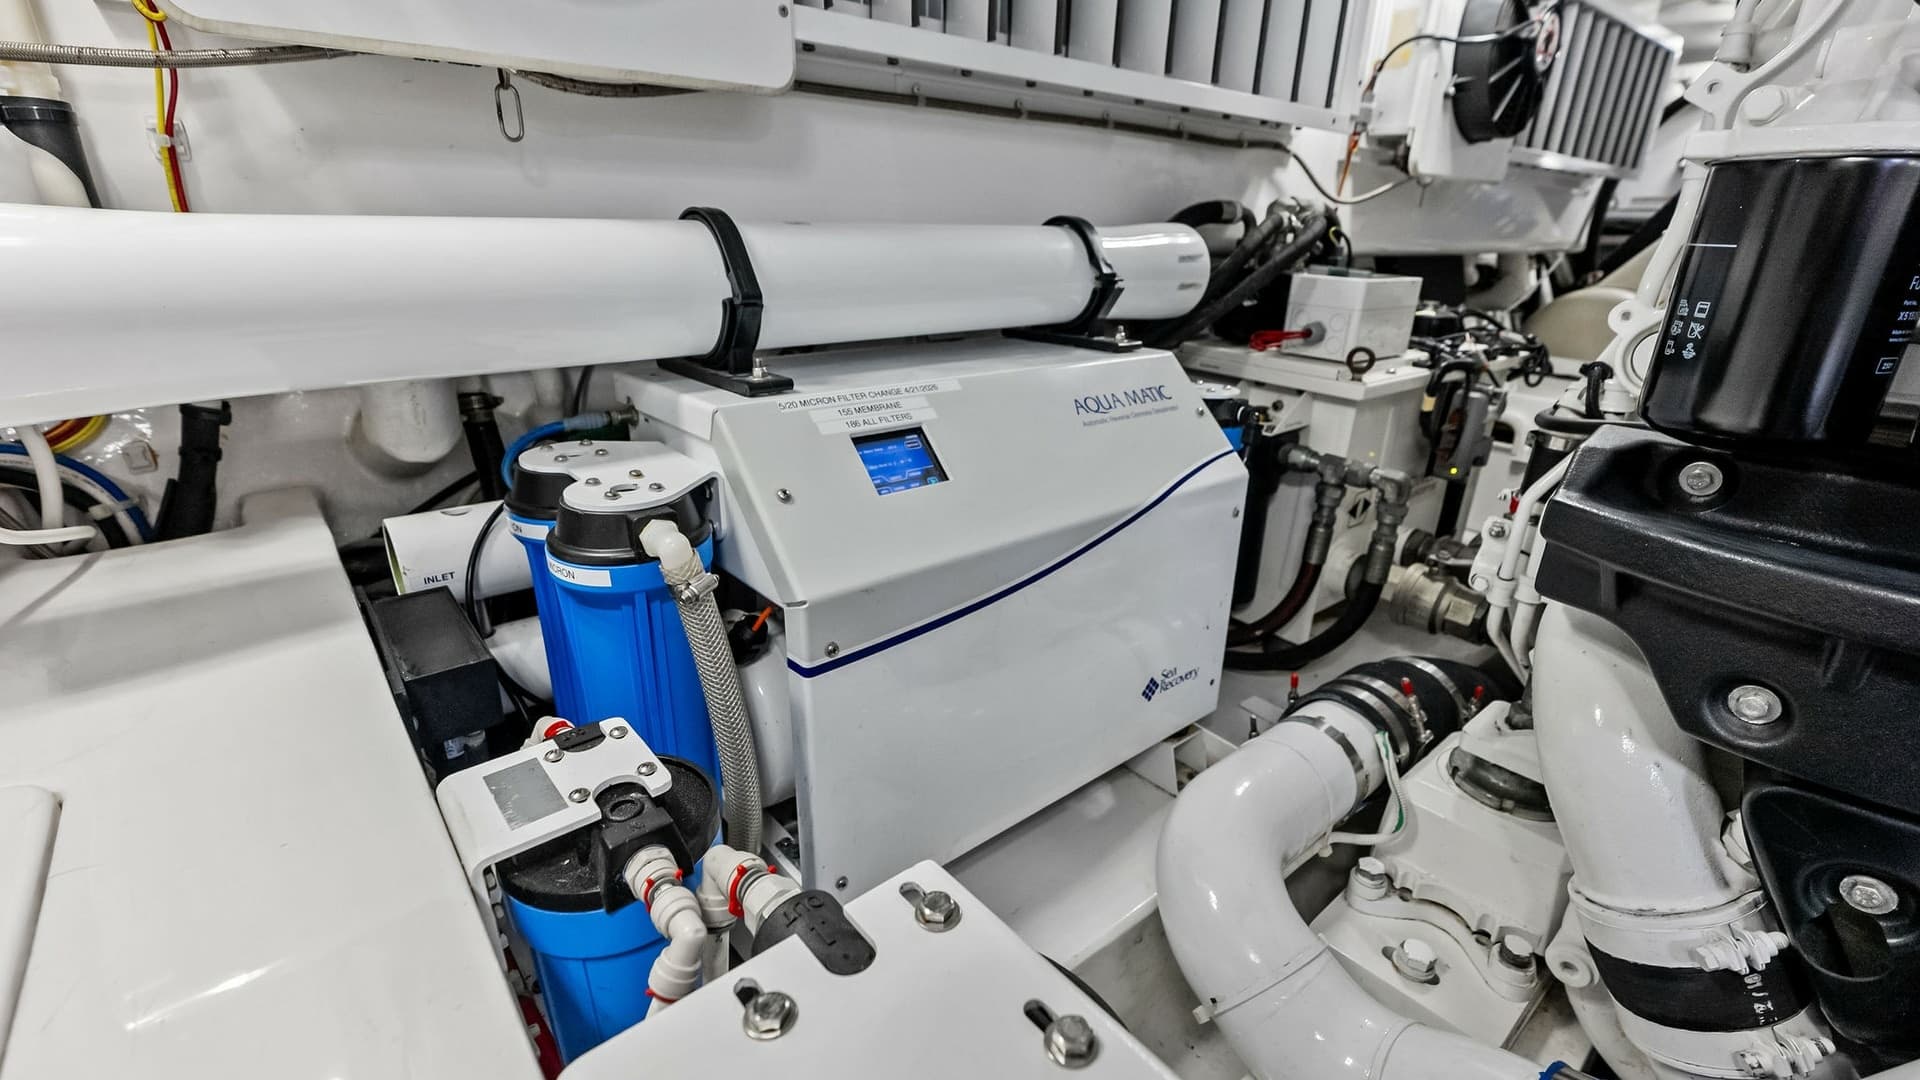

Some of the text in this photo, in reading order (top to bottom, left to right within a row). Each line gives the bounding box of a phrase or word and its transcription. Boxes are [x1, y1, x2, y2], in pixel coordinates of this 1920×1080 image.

[777, 401, 799, 411] 5/20
[799, 395, 836, 408] MICRON
[837, 391, 867, 403] FILTER
[868, 388, 904, 400] CHANGE
[854, 401, 903, 415] MEMBRANE
[1074, 393, 1126, 416] AQUA
[1123, 385, 1173, 407] MATIC
[862, 416, 878, 427] ALL
[879, 412, 913, 425] FILTERS
[423, 571, 456, 585] INLET
[1160, 666, 1200, 694] Recovery
[1161, 666, 1177, 679] Sea
[783, 895, 825, 929] OUT
